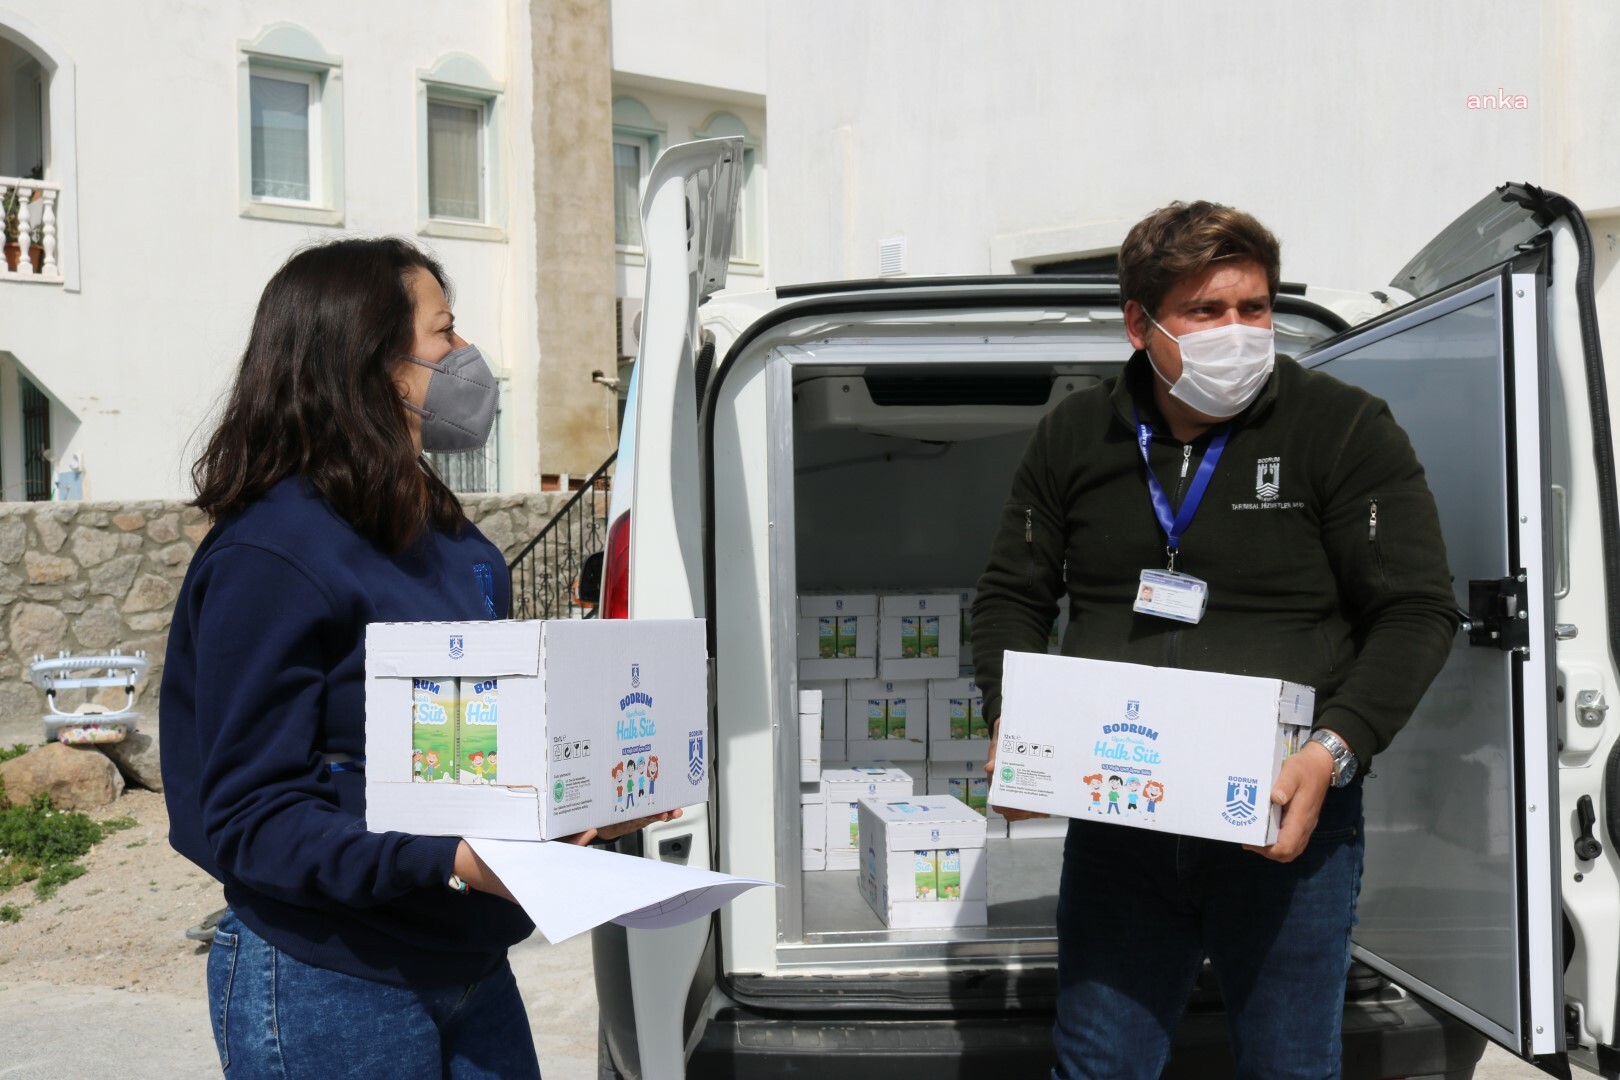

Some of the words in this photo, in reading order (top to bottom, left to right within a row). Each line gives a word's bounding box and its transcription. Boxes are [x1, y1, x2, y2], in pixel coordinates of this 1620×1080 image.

[620, 692, 653, 711] BODRUM
[418, 703, 446, 723] Süt
[616, 719, 639, 741] Halk
[639, 717, 657, 738] Süt
[1102, 722, 1159, 741] BODRUM
[1094, 740, 1131, 761] Halk
[1131, 745, 1162, 765] Süt
[1228, 775, 1258, 785] BODRUM
[1221, 811, 1258, 827] BELEDİYESİ
